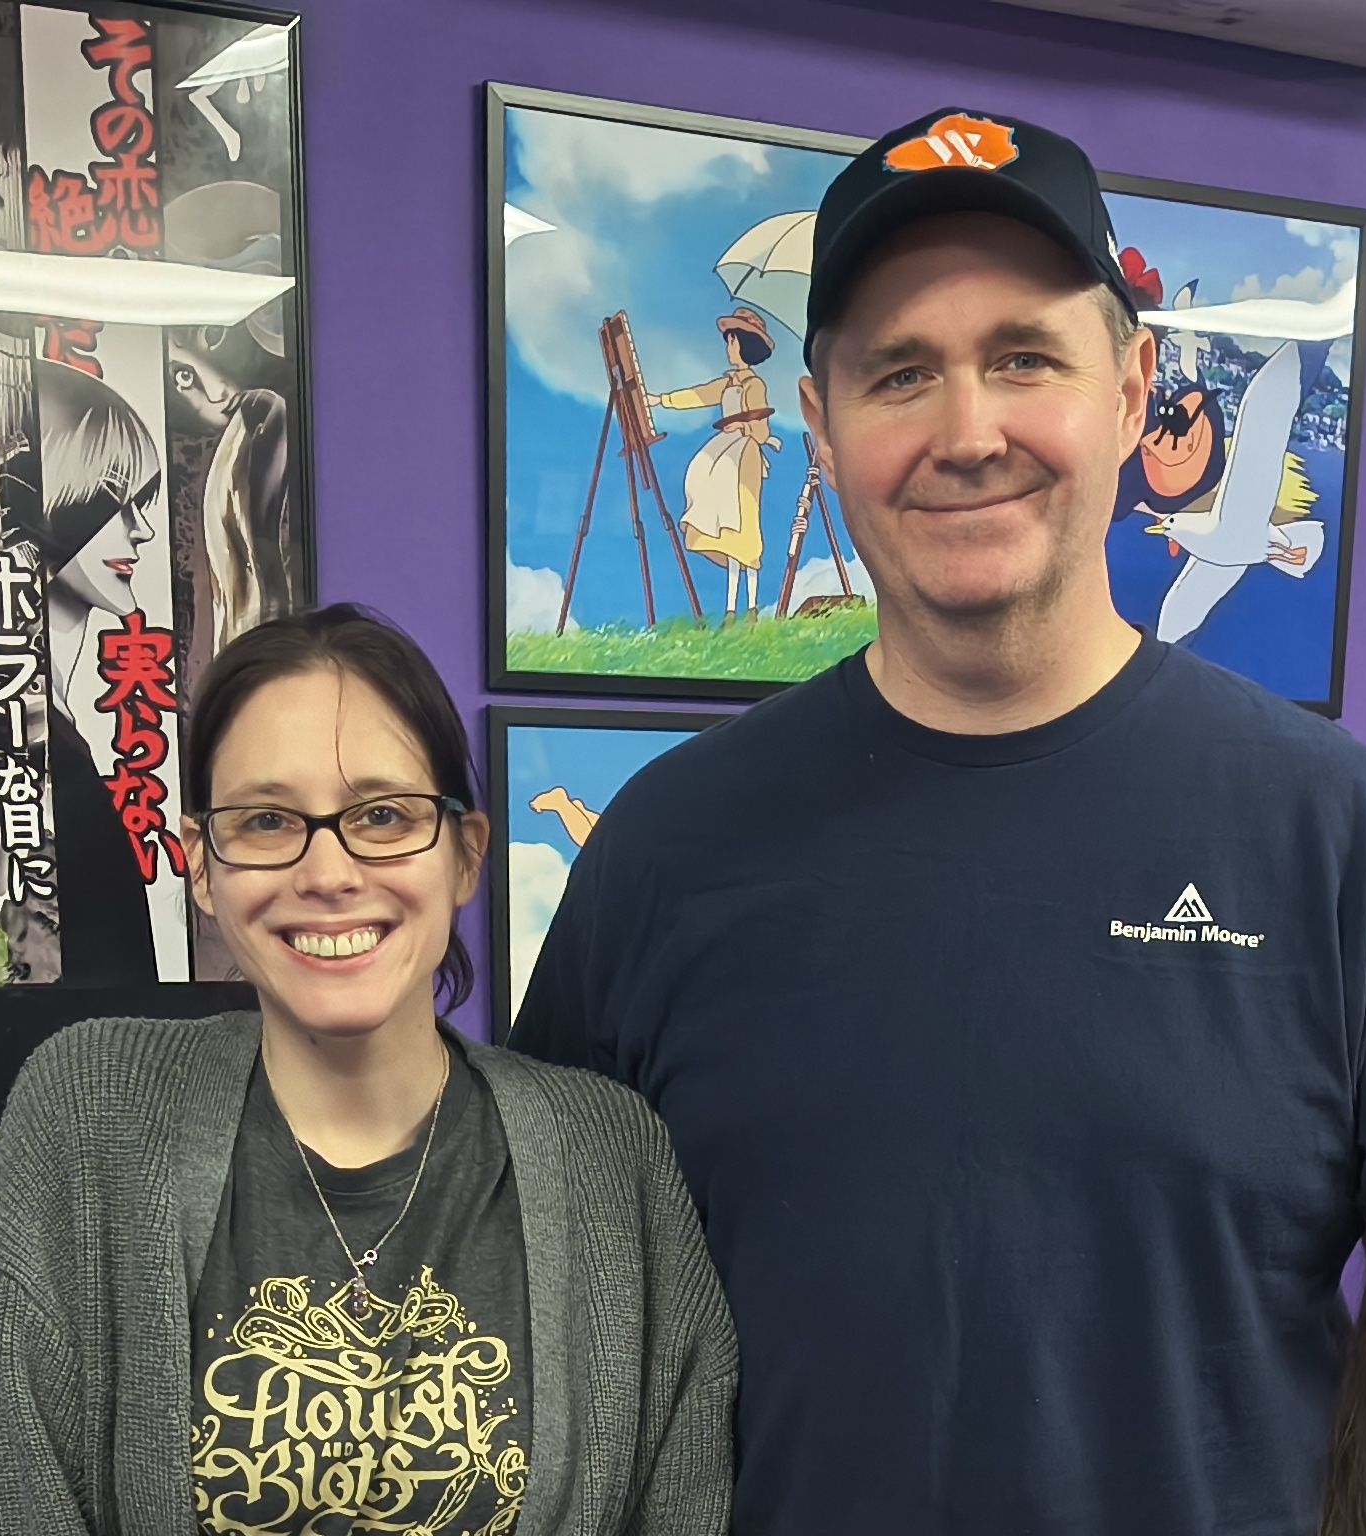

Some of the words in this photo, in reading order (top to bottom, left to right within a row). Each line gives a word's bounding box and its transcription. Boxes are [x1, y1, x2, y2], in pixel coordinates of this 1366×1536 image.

[89, 18, 160, 258] その恋
[96, 610, 187, 883] 実らない
[1110, 920, 1196, 943] Benjamin
[1201, 924, 1261, 948] Moore
[320, 1441, 354, 1458] AND
